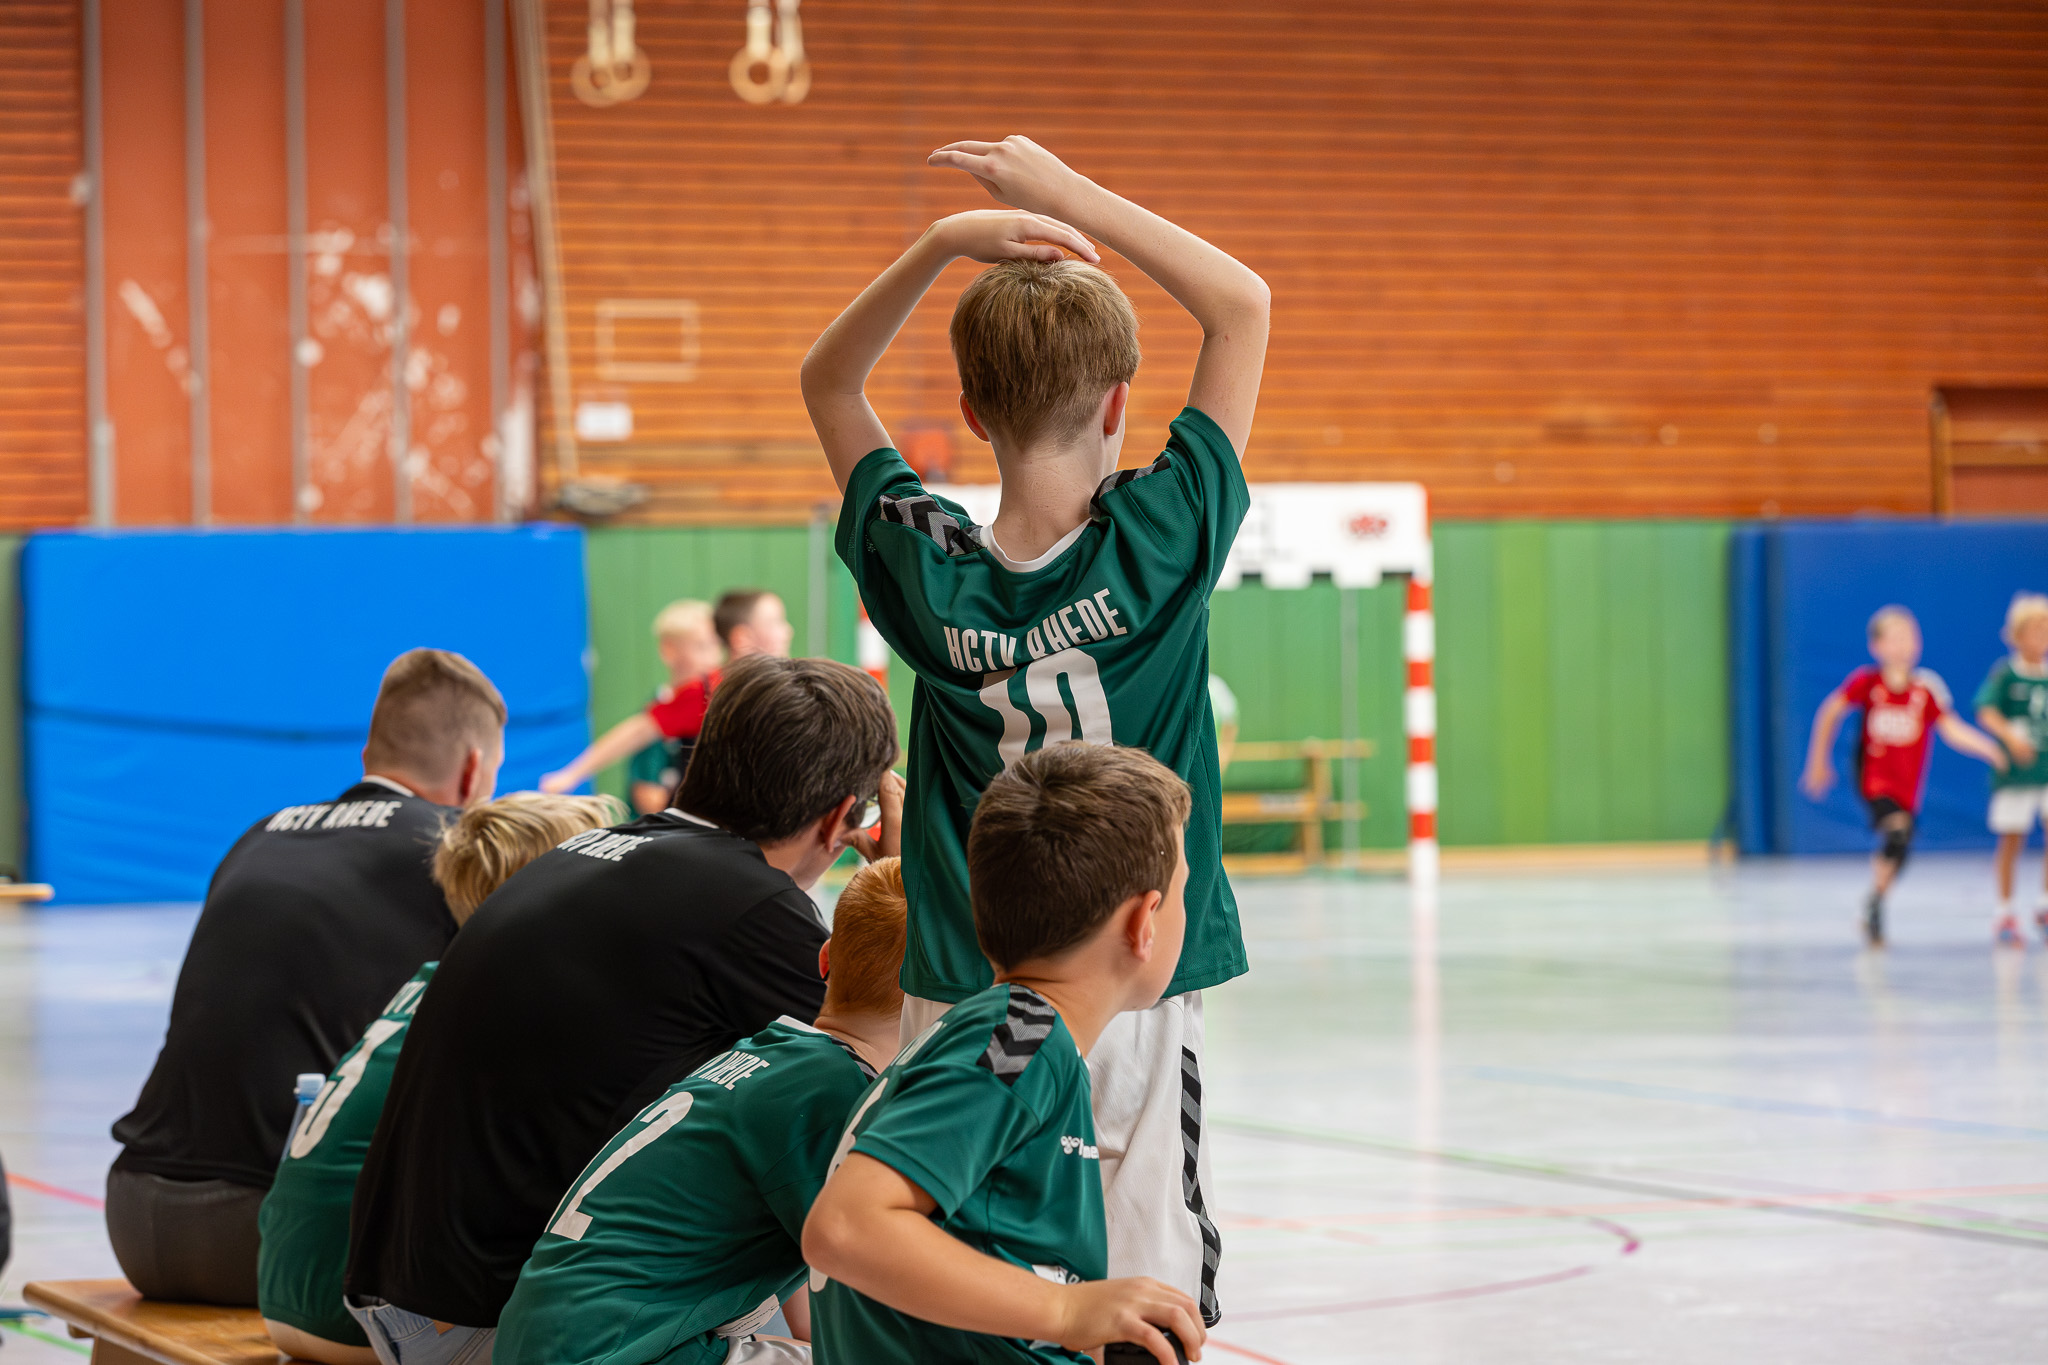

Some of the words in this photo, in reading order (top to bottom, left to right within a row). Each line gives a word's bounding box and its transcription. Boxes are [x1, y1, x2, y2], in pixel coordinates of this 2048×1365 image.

[943, 626, 1017, 673] HCTV
[1026, 588, 1128, 660] RHEDE
[979, 647, 1114, 772] 10
[698, 1050, 770, 1091] RHEDE
[544, 1089, 694, 1242] 2
